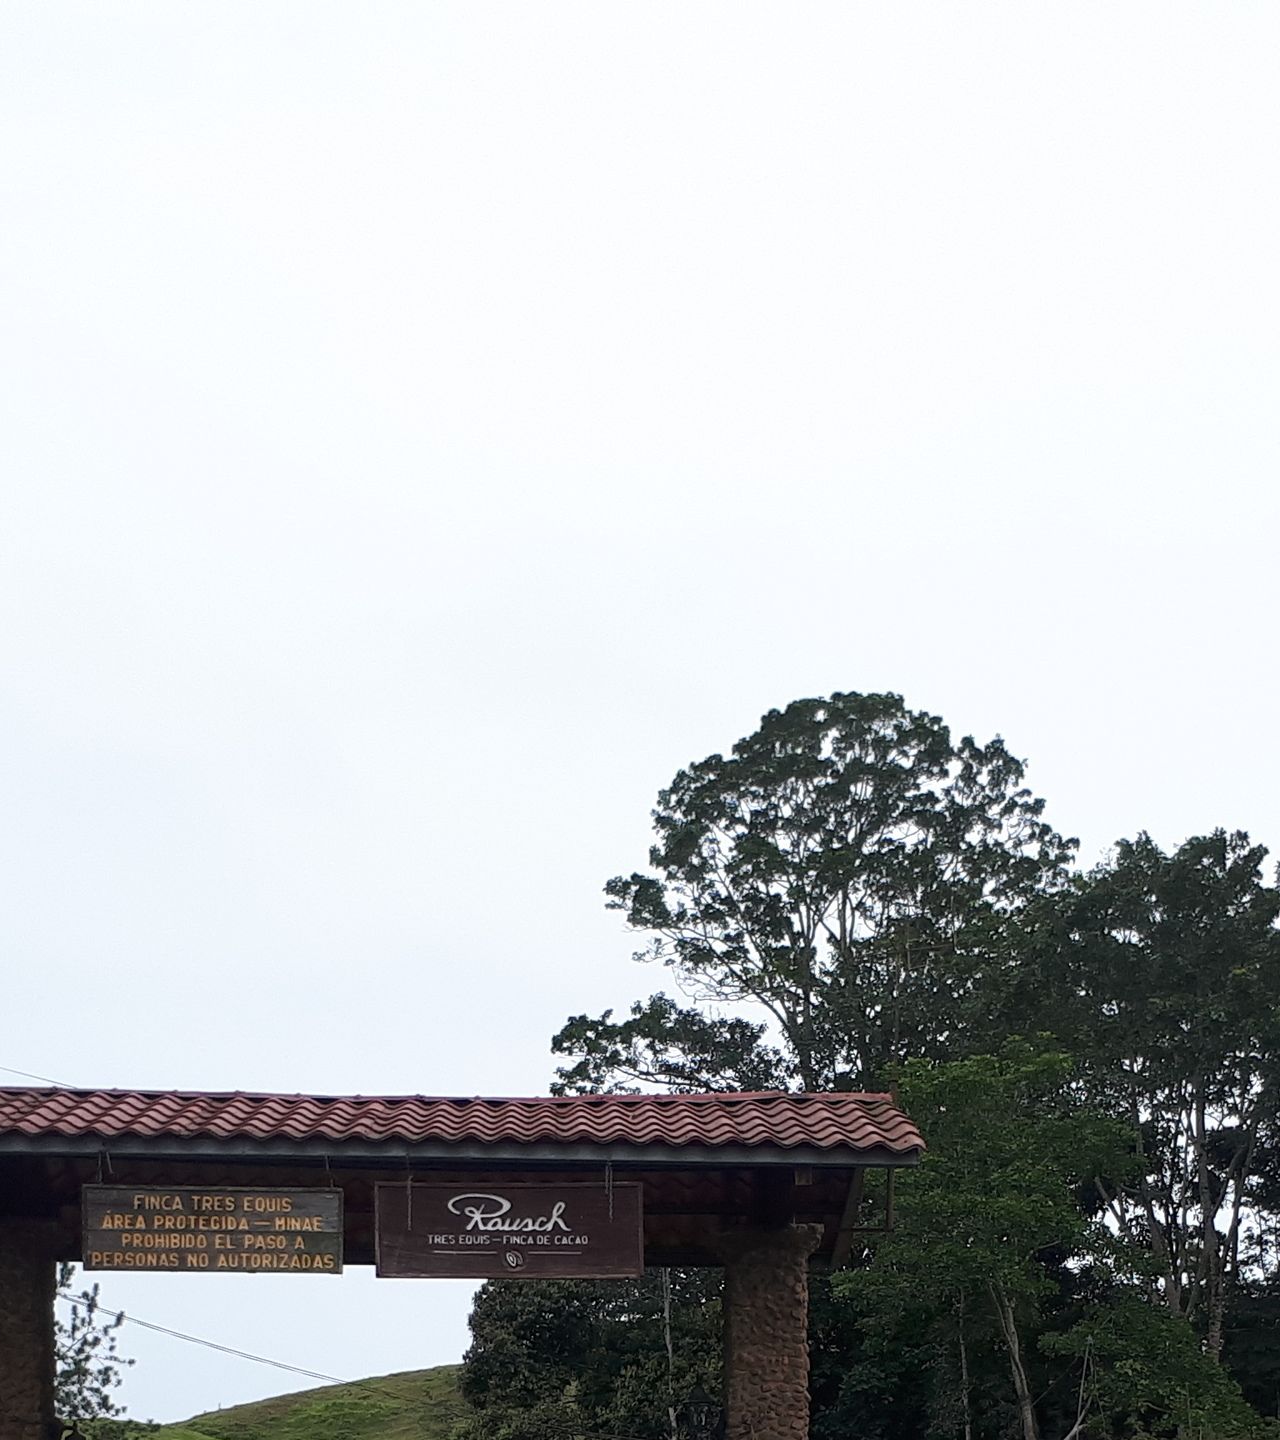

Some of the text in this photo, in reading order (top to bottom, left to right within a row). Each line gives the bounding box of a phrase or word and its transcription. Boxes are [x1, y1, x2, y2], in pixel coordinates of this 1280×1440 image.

[133, 1195, 292, 1213] FINCA TRES EQUIS
[448, 1193, 572, 1232] Rausch
[154, 1215, 249, 1230] PROTEGIDA
[275, 1217, 323, 1232] MINAE
[122, 1233, 305, 1250] PROHIBIDO EL PASO A
[427, 1234, 456, 1245] TRES
[503, 1234, 534, 1245] FINCA
[536, 1234, 551, 1245] DE
[554, 1234, 589, 1245] CACAO
[91, 1252, 335, 1269] PERSONAS NO AUTORIZADAS
